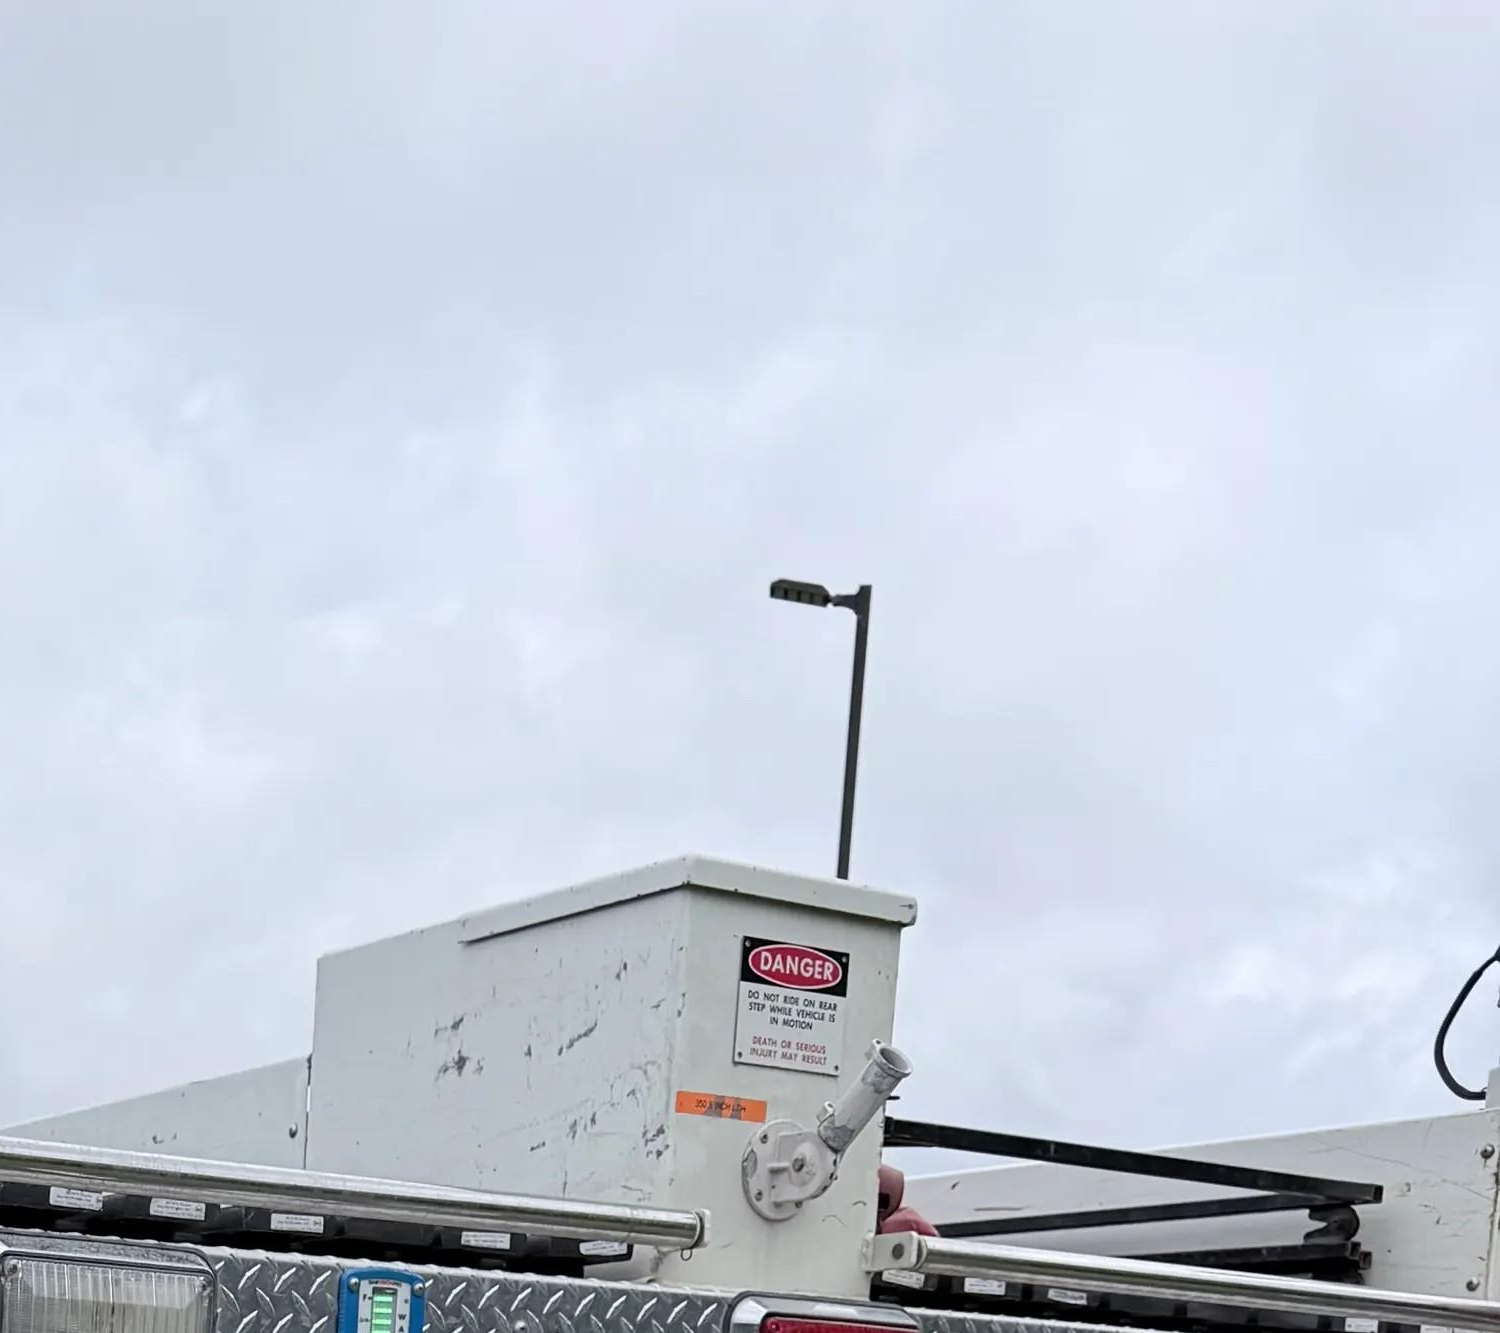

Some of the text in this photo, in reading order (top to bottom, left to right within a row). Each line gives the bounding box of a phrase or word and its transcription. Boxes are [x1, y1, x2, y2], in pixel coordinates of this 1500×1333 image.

[760, 951, 834, 981] DANGER
[748, 990, 838, 1011] DO NOT RIDE ON REAR
[748, 1002, 835, 1023] STEP WHILE VEHICLE IS
[770, 1016, 813, 1030] IN MOTION
[752, 1036, 826, 1054] DEATH OR SERIOUS
[750, 1047, 828, 1065] INJURY MAY RESULT
